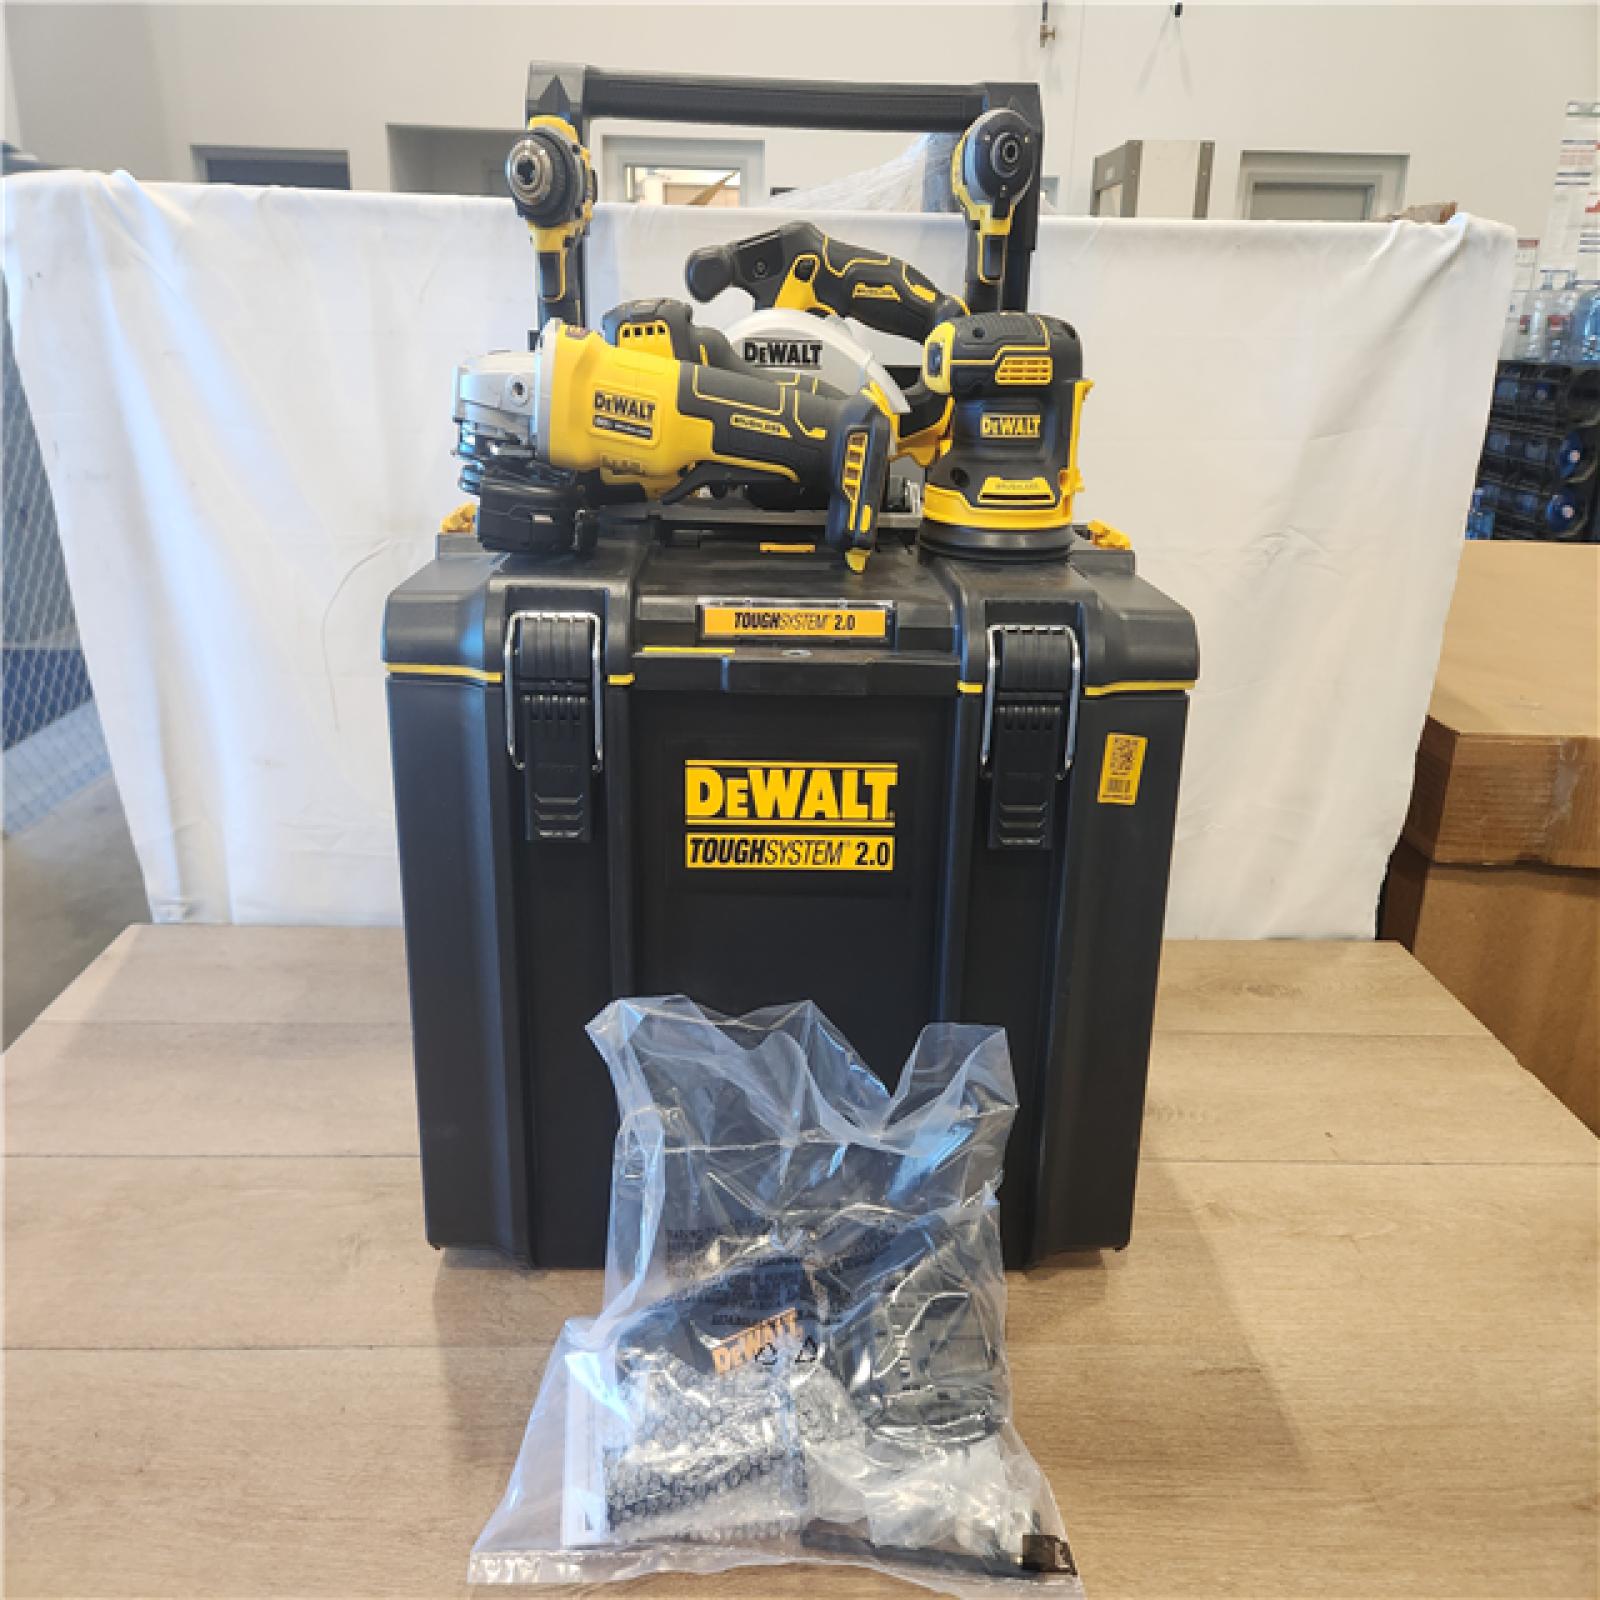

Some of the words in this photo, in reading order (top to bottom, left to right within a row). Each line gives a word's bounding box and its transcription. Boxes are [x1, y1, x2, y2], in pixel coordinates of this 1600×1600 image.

[744, 341, 823, 364] DEWALT
[594, 390, 656, 421] DEWALT
[981, 415, 1041, 436] DEWALT
[834, 614, 856, 631] 2.0
[685, 766, 898, 820] DEWALT
[854, 841, 890, 866] 2.0
